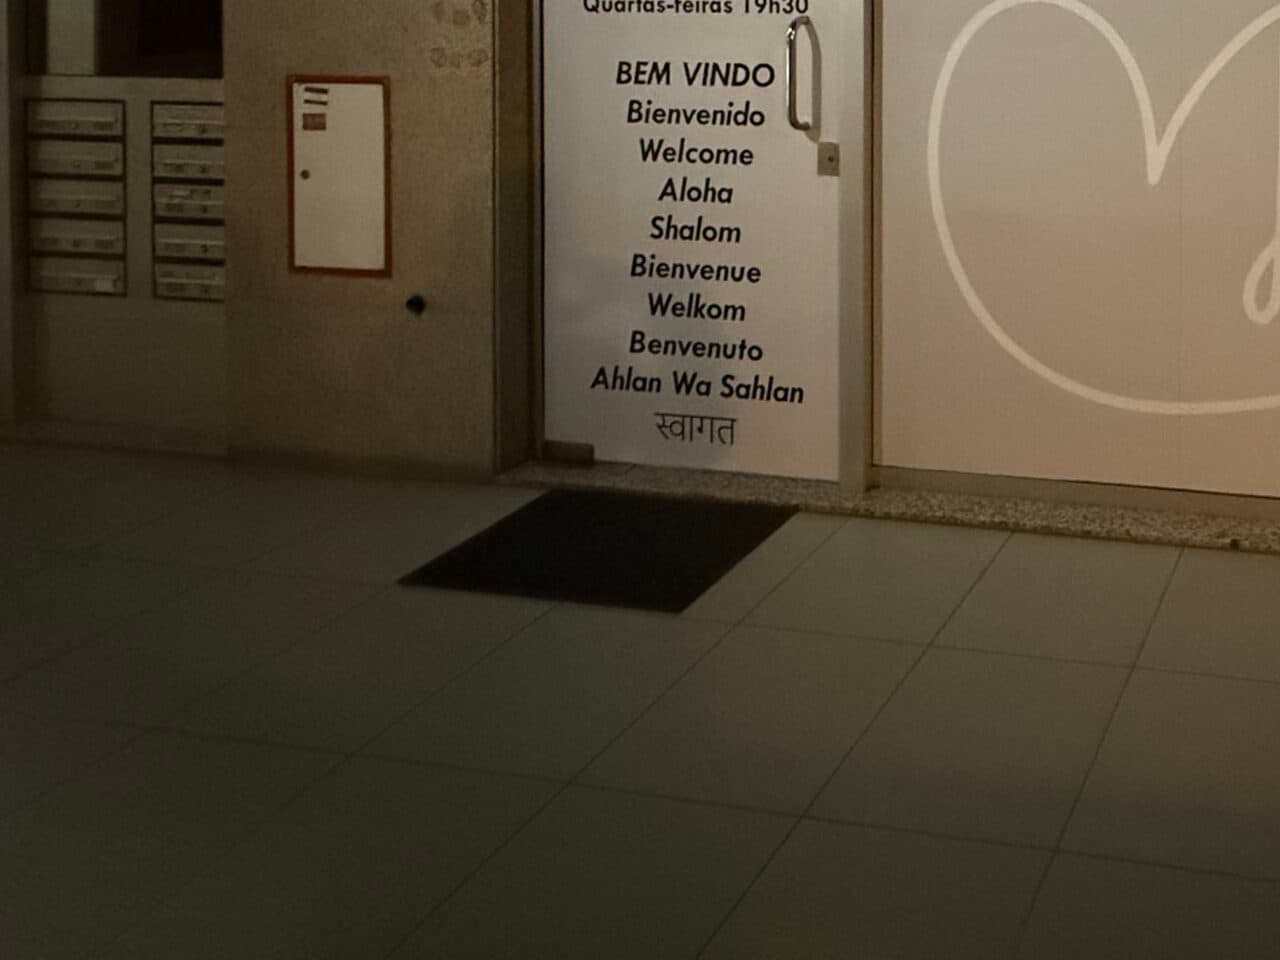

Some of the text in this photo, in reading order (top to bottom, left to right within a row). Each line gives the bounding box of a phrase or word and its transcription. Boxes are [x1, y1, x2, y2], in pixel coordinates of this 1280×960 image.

[615, 60, 776, 88] BEM VINDO
[626, 99, 765, 127] Bienvenido
[639, 137, 754, 166] Welcome
[657, 176, 734, 204] Aloha
[649, 214, 741, 244] Shalom
[630, 253, 762, 284] Bienvenue
[647, 292, 746, 322] Welkom
[629, 329, 764, 362] Benvenuto
[589, 364, 804, 404] Ahlan Wa Sahlan
[653, 411, 737, 446] स्वागत
